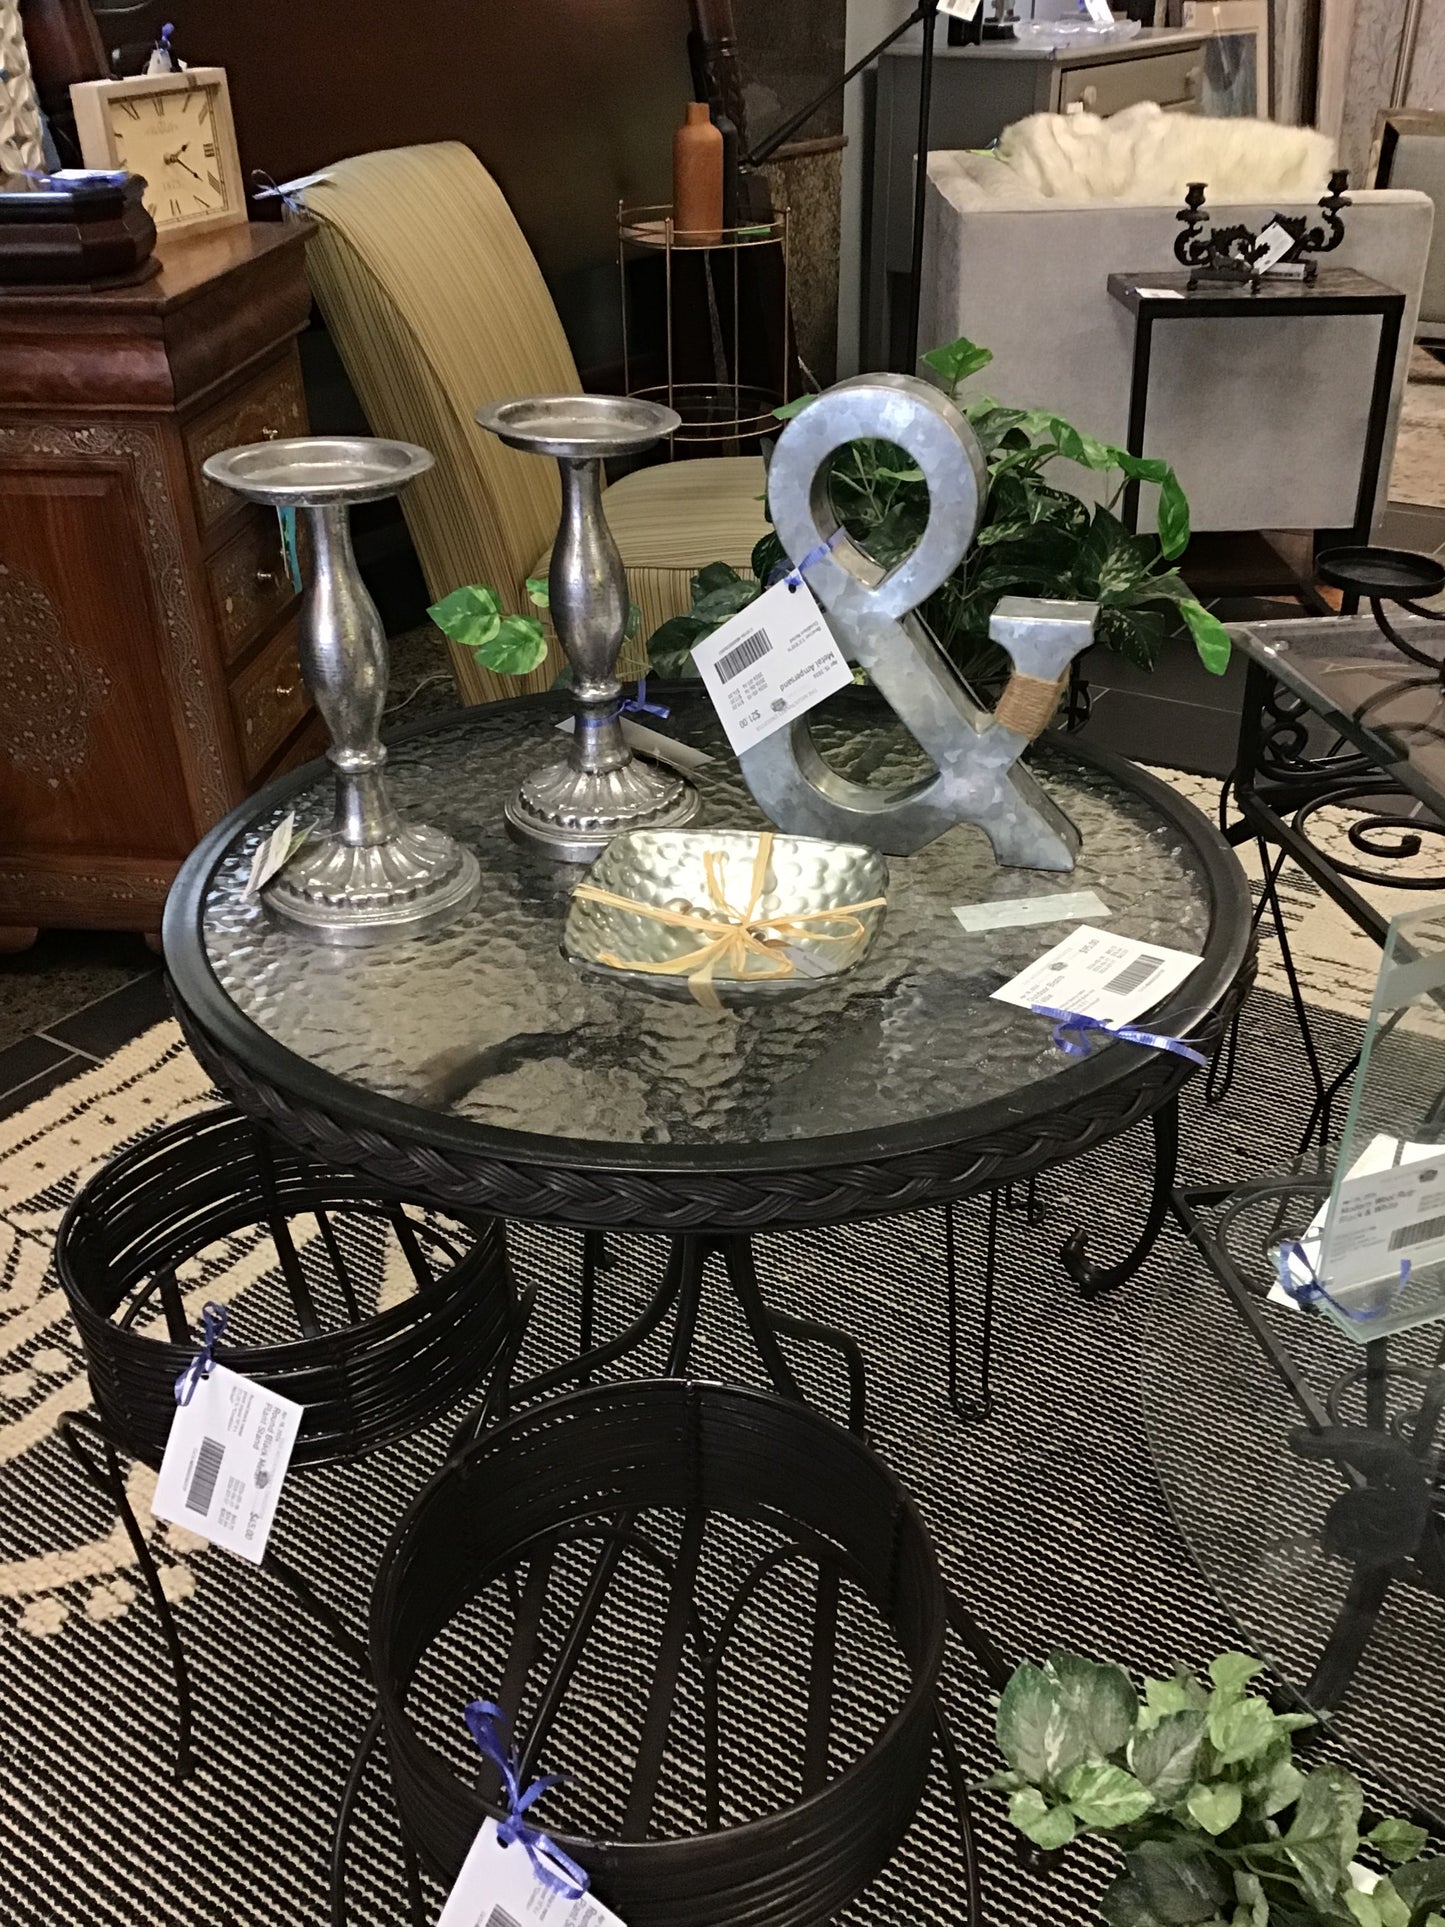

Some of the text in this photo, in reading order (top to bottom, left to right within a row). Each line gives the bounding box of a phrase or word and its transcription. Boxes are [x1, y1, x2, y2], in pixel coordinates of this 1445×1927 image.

[778, 650, 834, 693] Metal Ampersand
[738, 708, 760, 729] $21.00
[259, 1401, 272, 1425] Plant
[266, 1406, 281, 1434] Round
[251, 1425, 266, 1451] Stand
[259, 1433, 273, 1457] Black
[243, 1511, 260, 1542] $45.00
